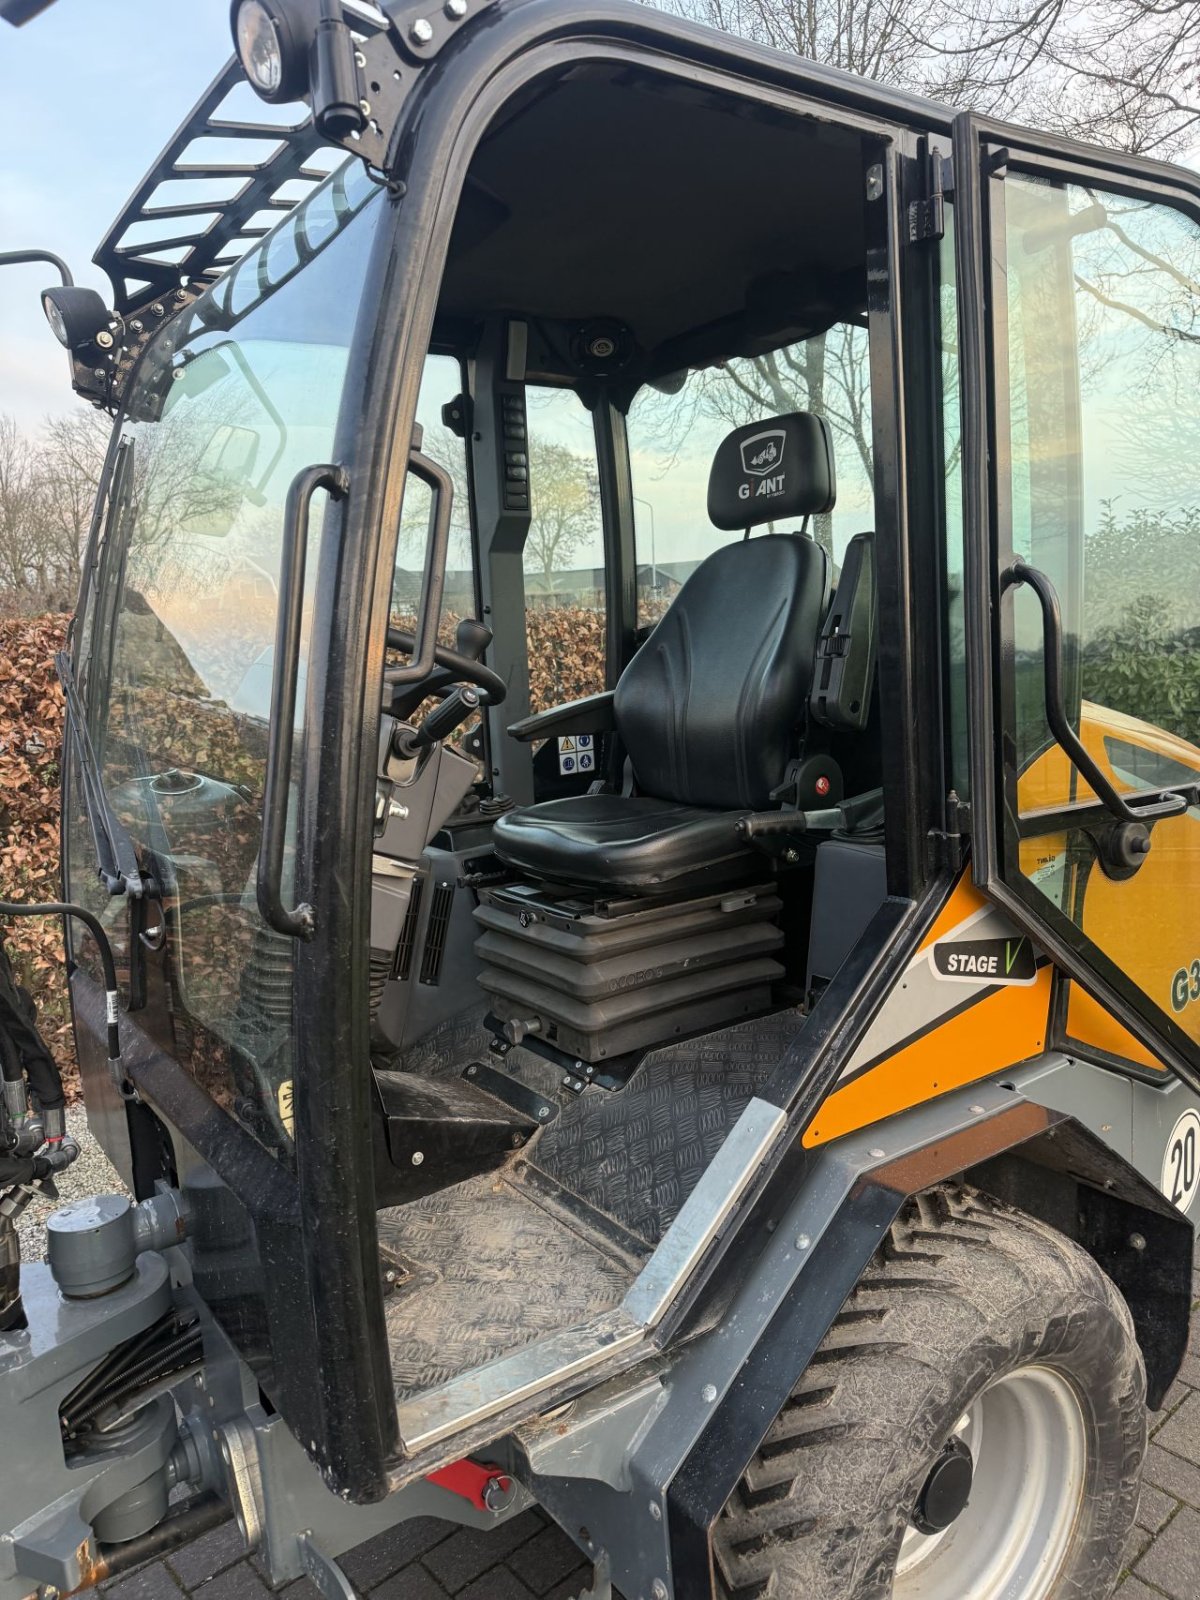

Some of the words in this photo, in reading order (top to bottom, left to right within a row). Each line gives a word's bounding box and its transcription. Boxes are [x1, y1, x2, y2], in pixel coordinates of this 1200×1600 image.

[947, 953, 998, 974] STAGE
[1005, 935, 1026, 975] V
[1171, 1126, 1196, 1206] 20
